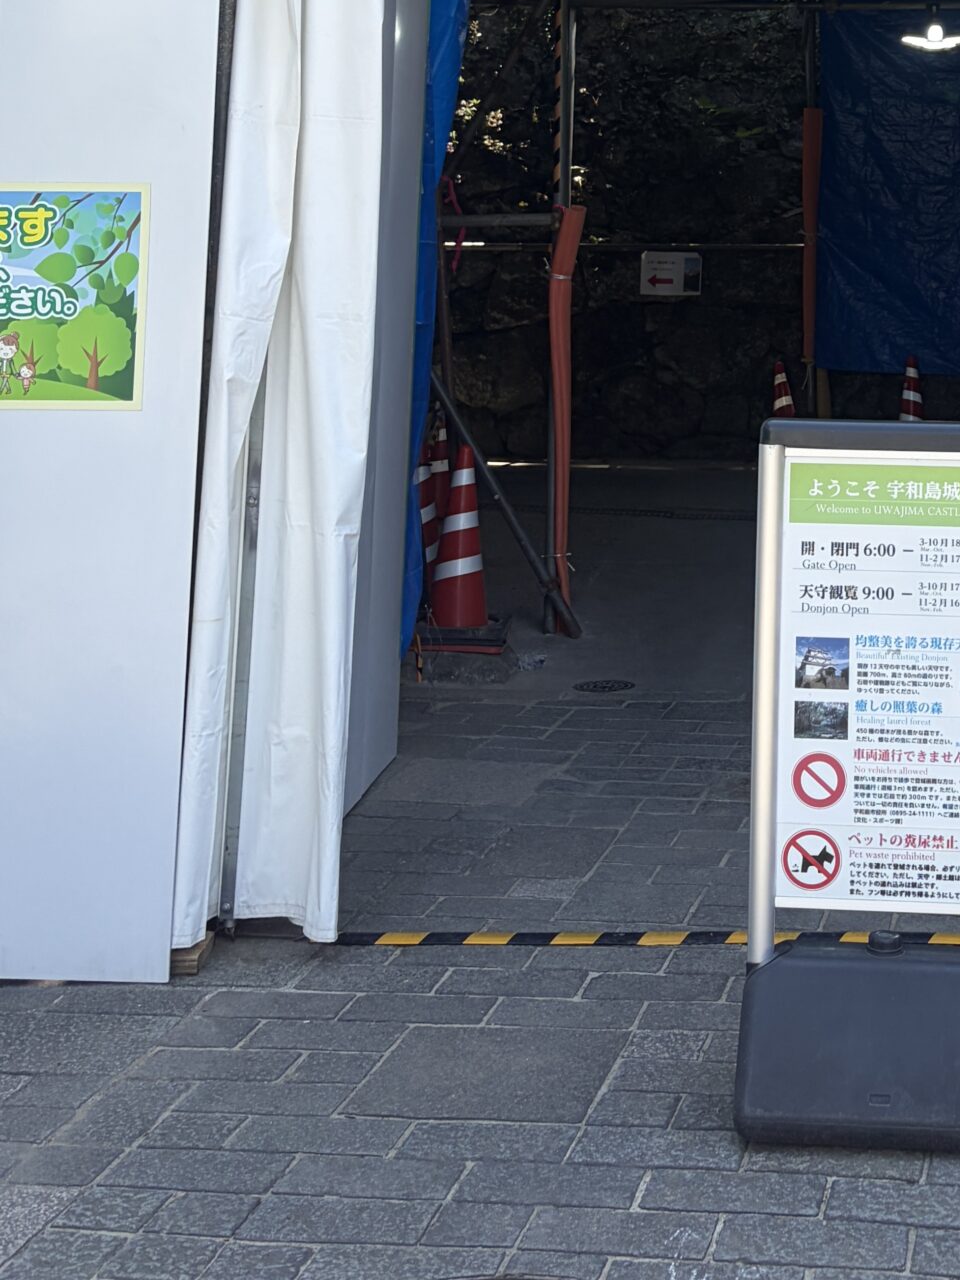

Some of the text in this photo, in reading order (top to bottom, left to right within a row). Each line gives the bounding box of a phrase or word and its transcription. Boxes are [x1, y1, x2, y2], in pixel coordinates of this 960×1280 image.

[0, 204, 56, 245] す
[808, 479, 880, 498] ようこそ
[816, 503, 859, 514] Welcome
[861, 506, 871, 514] to
[874, 505, 924, 518] UWAJIMA
[801, 541, 860, 557] 開・閉門
[863, 543, 896, 557] 6:00
[802, 560, 856, 573] Gate Open
[799, 584, 859, 600] 天守観覧
[862, 586, 894, 600] 9:00
[801, 603, 869, 616] Donjon Open
[848, 832, 958, 849] ペットの糞尿禁止
[849, 850, 863, 858] Pet
[892, 852, 936, 862] prohibited
